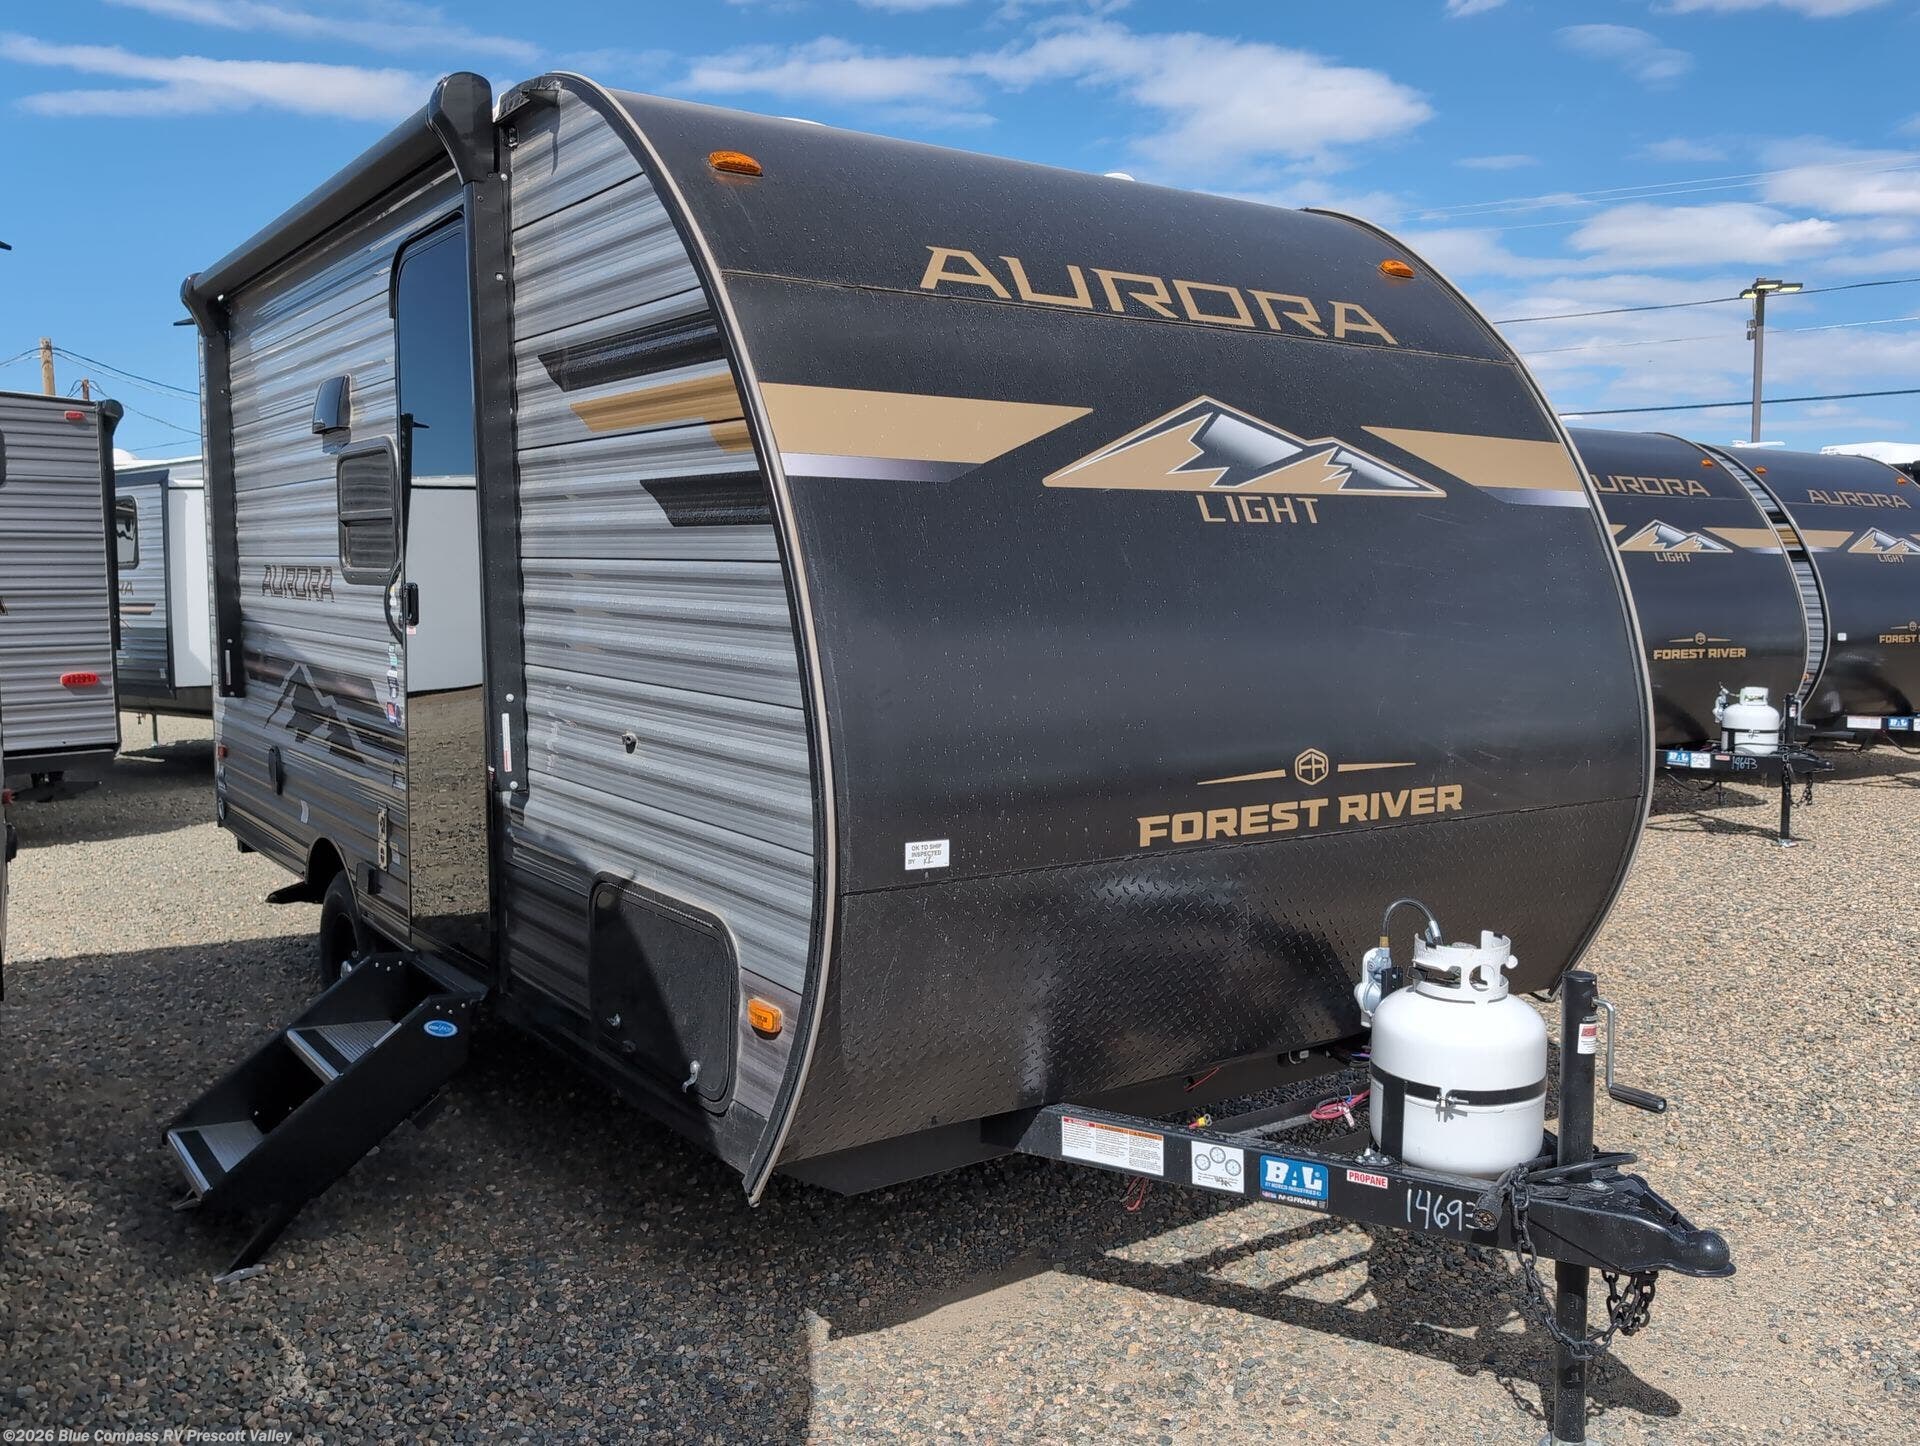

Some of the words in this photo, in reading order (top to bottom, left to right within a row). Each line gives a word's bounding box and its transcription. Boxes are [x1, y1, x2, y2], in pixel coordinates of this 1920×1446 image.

[919, 245, 1399, 344] AURORA
[1590, 474, 1711, 497] URORA
[1196, 494, 1319, 523] LIGHT
[1807, 489, 1912, 509] AURORA
[1654, 551, 1691, 562] LIGHT
[1877, 554, 1905, 563] LIGHT
[262, 564, 335, 603] AURORA
[1879, 634, 1917, 644] FOREST
[1653, 648, 1705, 660] FOREST
[1708, 647, 1747, 659] RIVER
[1137, 798, 1329, 847] FOREST
[1338, 784, 1463, 825] RIVER
[1265, 1160, 1323, 1191] BAL
[1348, 1171, 1387, 1188] PROPANE
